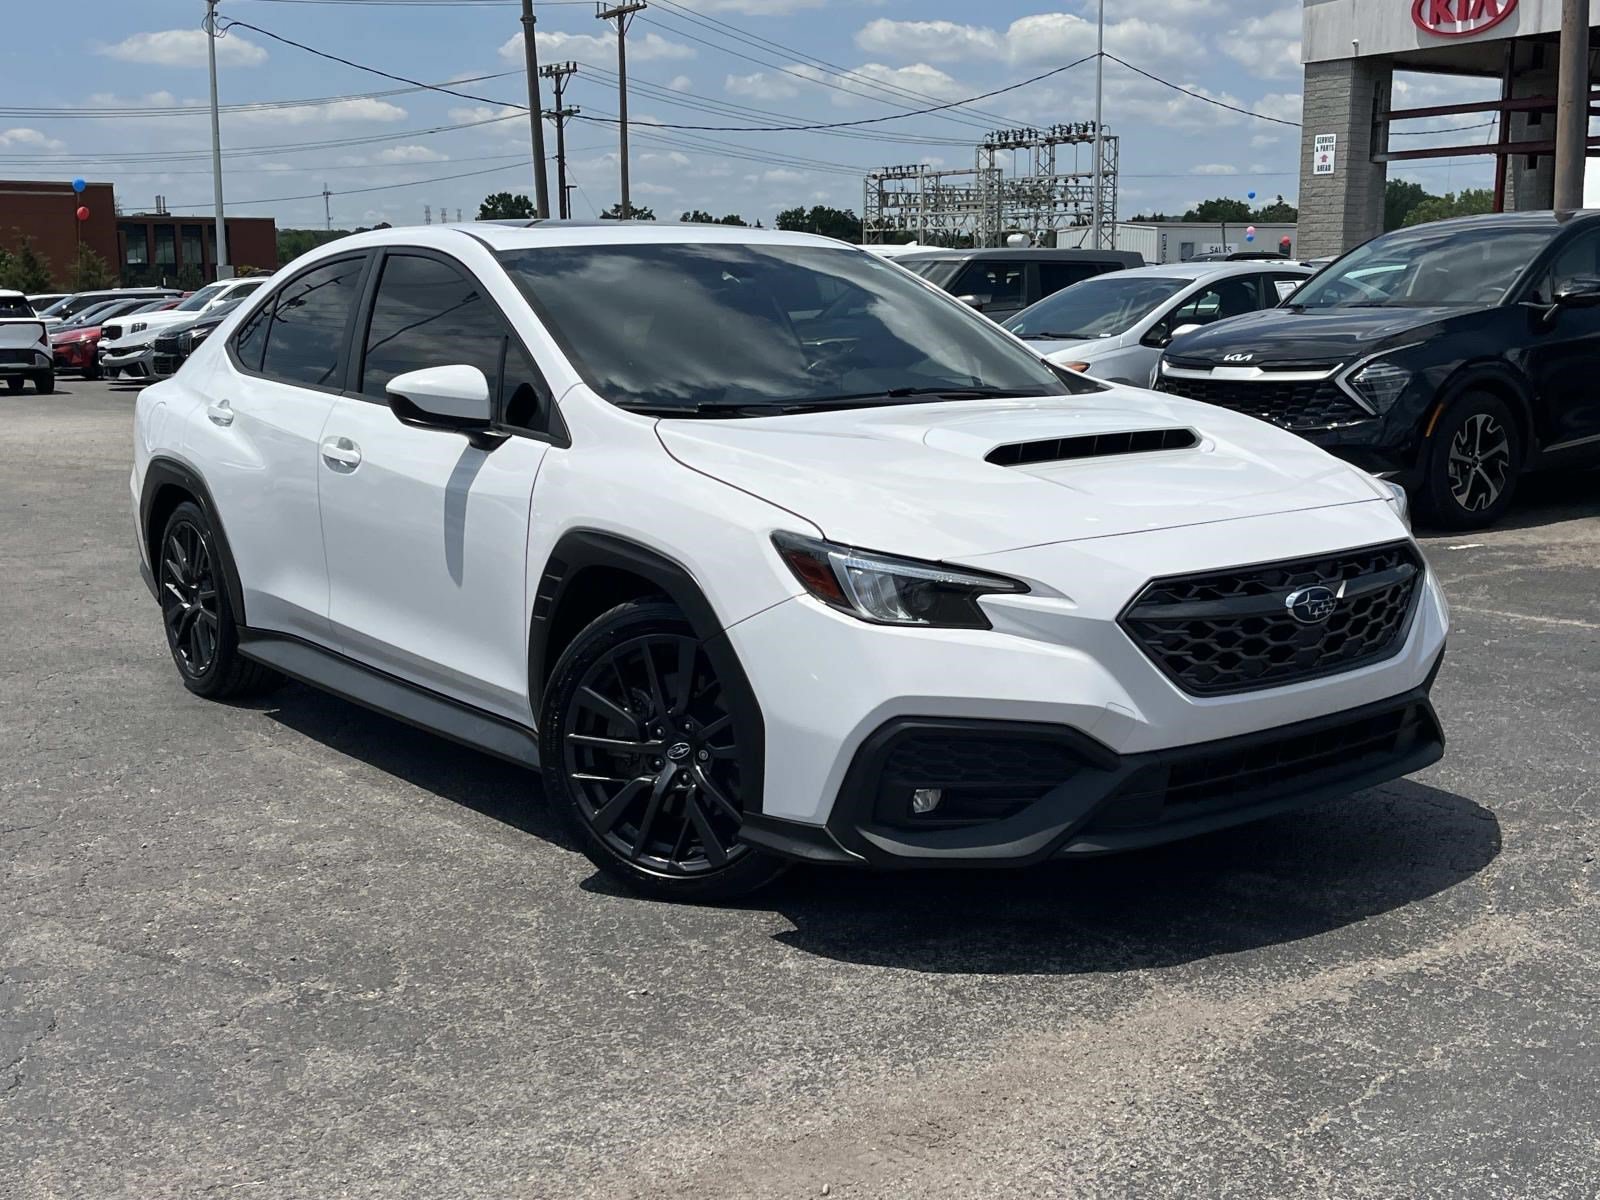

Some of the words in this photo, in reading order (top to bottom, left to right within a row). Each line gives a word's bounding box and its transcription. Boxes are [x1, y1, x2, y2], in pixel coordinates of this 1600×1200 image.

[1430, 0, 1498, 25] KIA
[1316, 136, 1334, 144] SERVICE
[1320, 144, 1335, 152] PARTS
